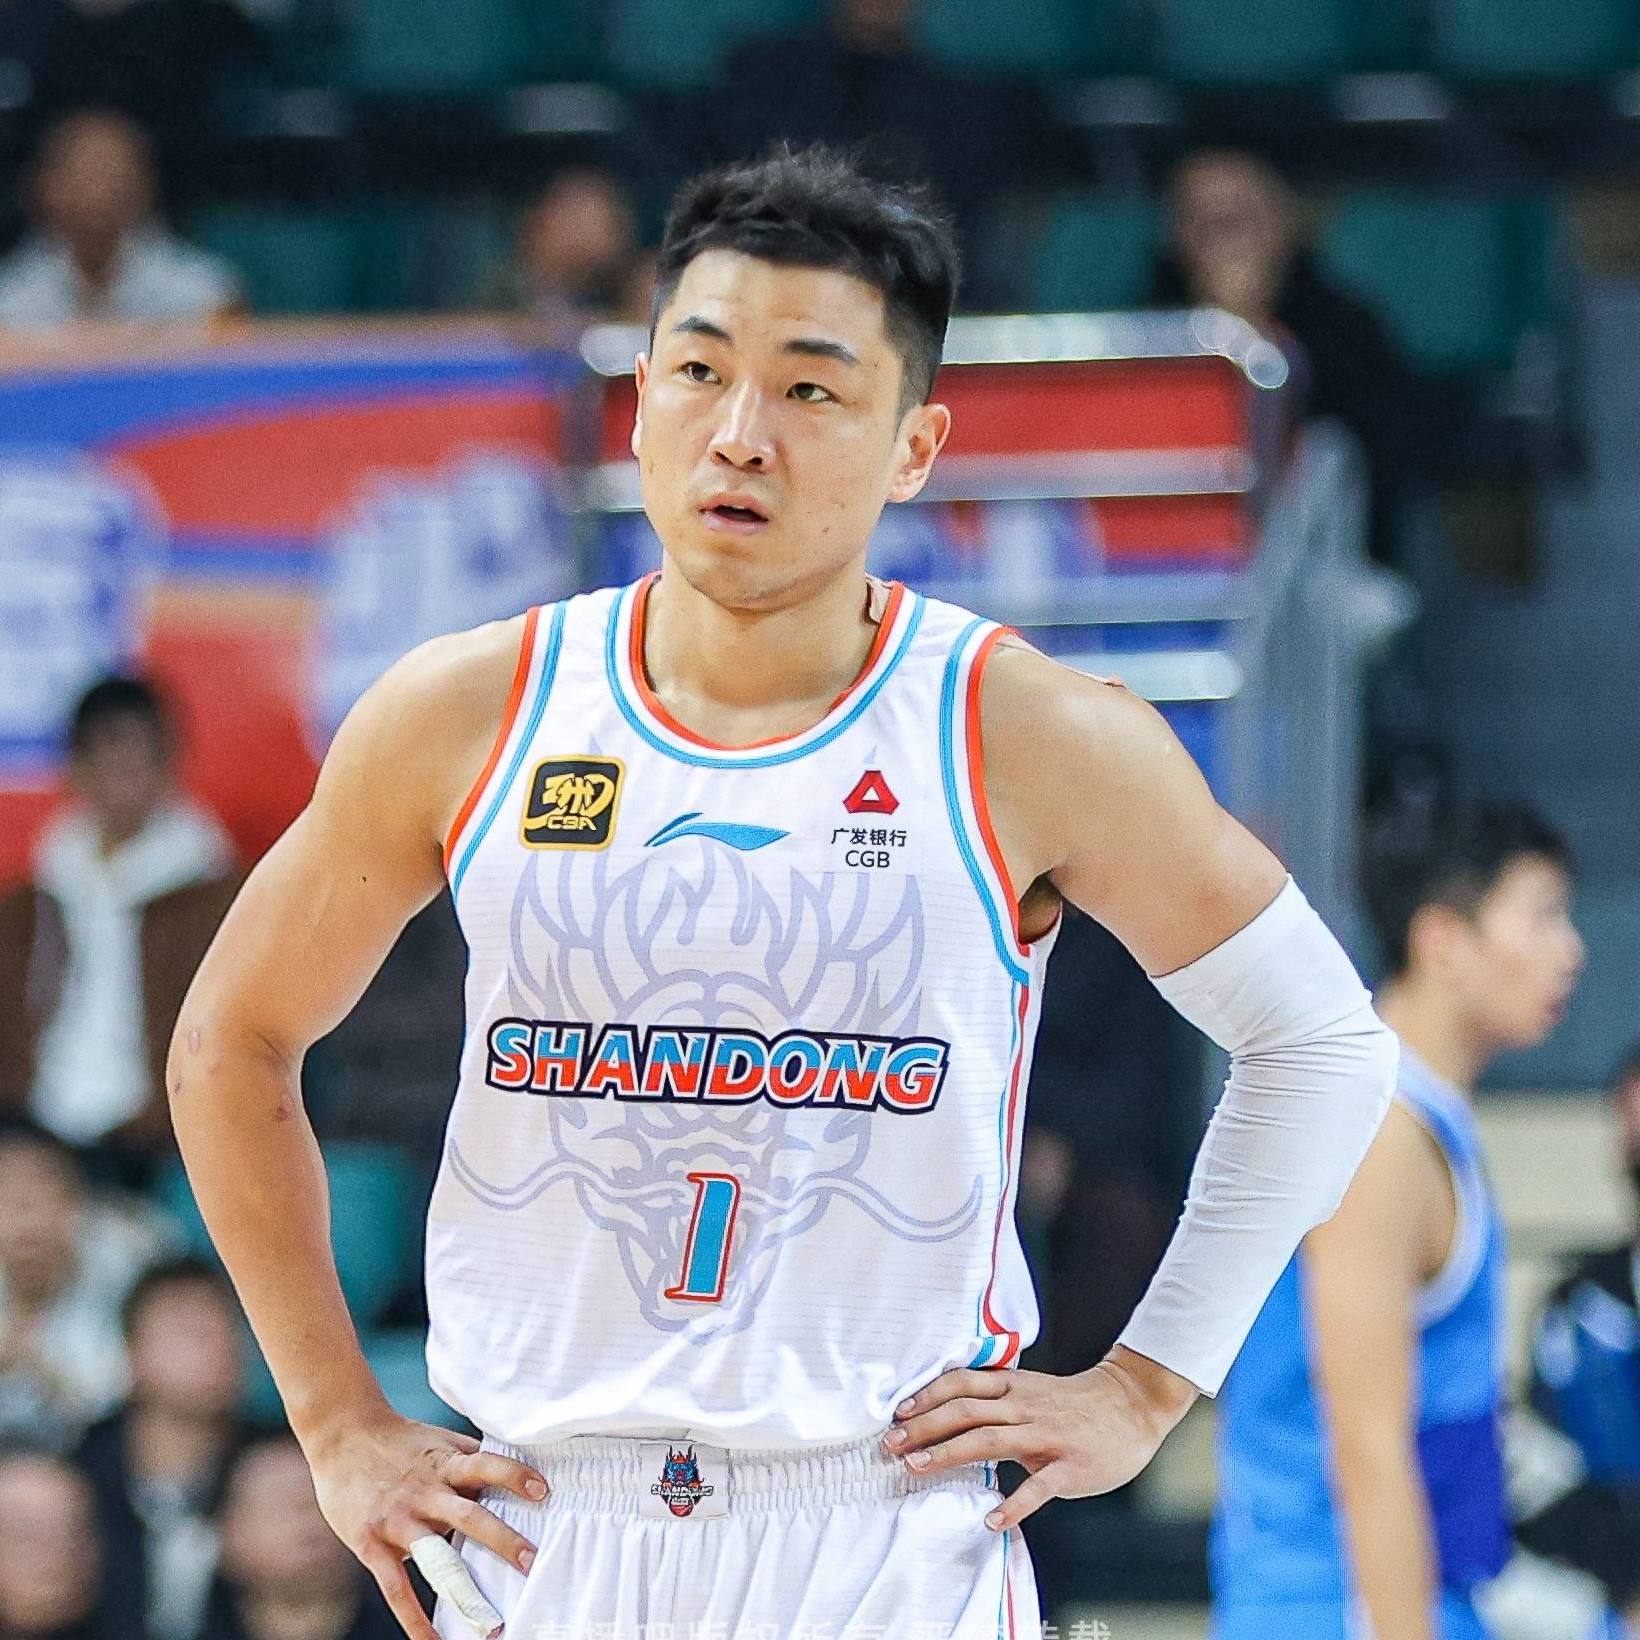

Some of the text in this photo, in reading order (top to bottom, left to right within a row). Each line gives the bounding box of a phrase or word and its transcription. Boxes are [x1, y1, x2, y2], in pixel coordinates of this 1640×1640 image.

[547, 814, 597, 831] CBA
[831, 827, 907, 847] 广发银行
[845, 849, 891, 868] CGB
[485, 1017, 952, 1116] SHANDONG
[664, 1170, 742, 1303] 1
